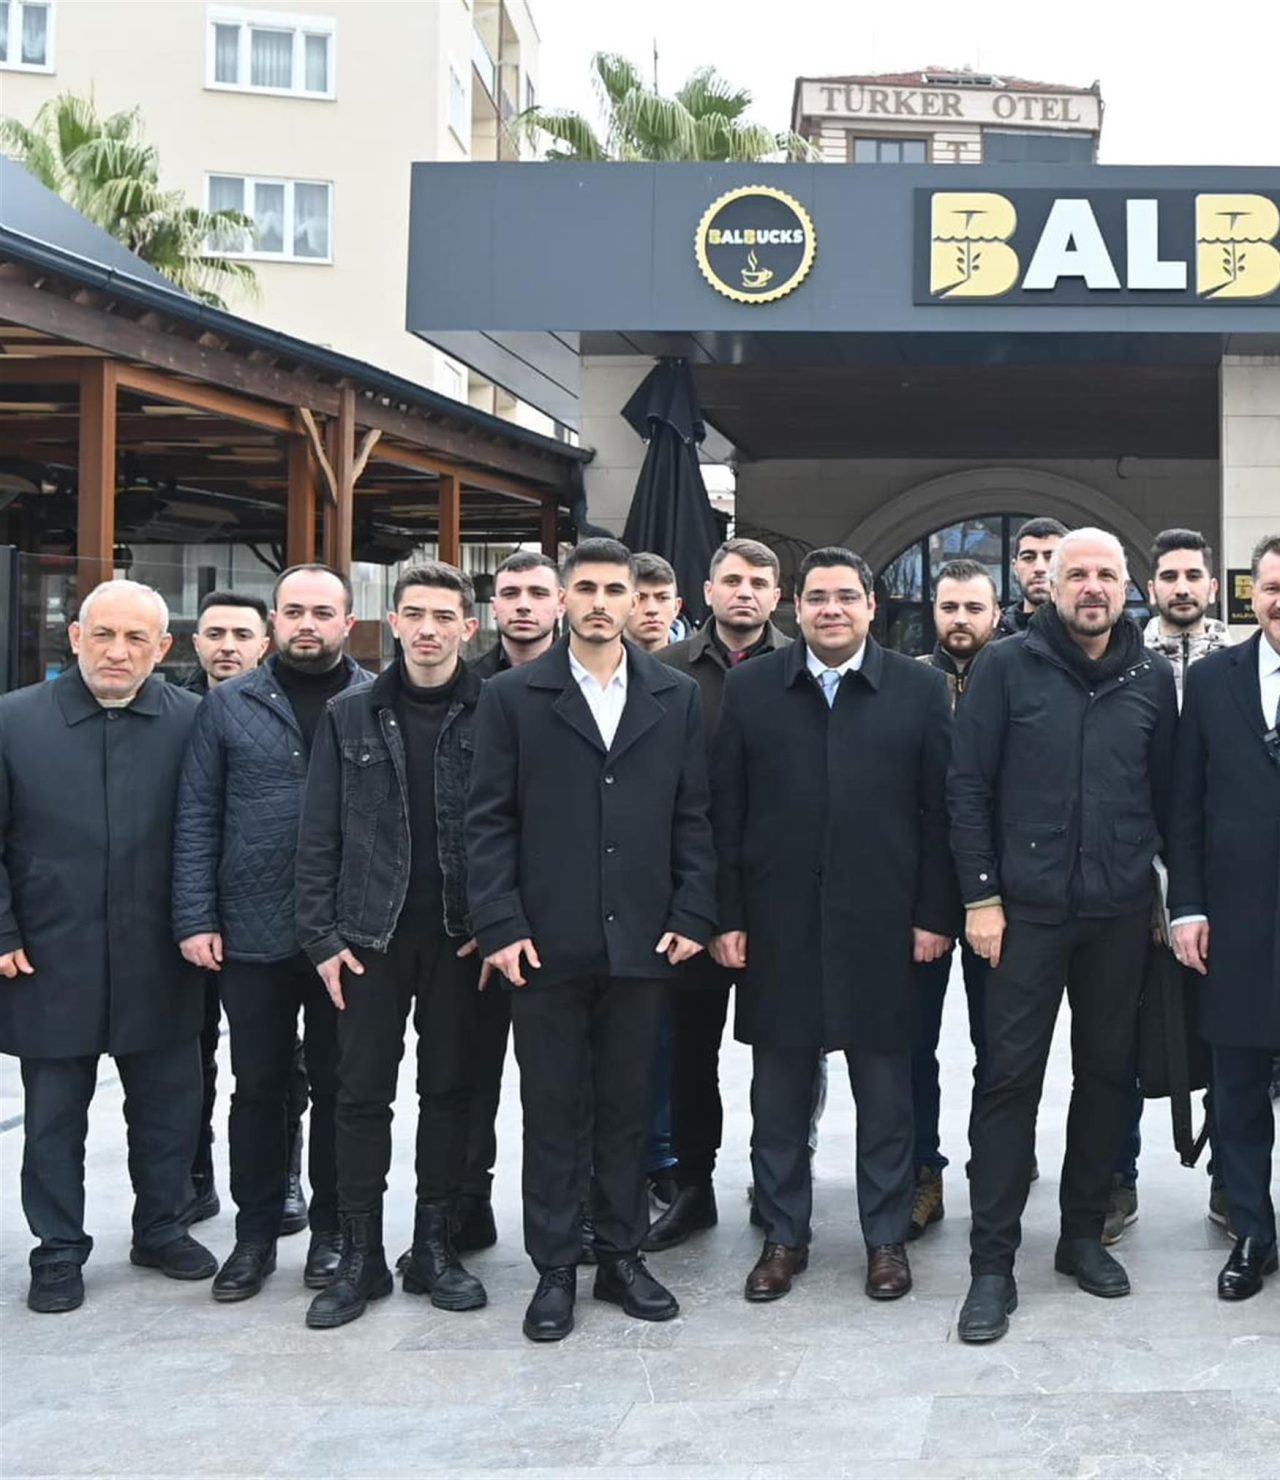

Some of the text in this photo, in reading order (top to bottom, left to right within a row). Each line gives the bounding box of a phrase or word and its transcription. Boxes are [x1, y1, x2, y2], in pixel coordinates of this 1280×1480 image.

[820, 84, 1082, 123] TÜRKER OTEL
[708, 229, 804, 244] BALBUCKS
